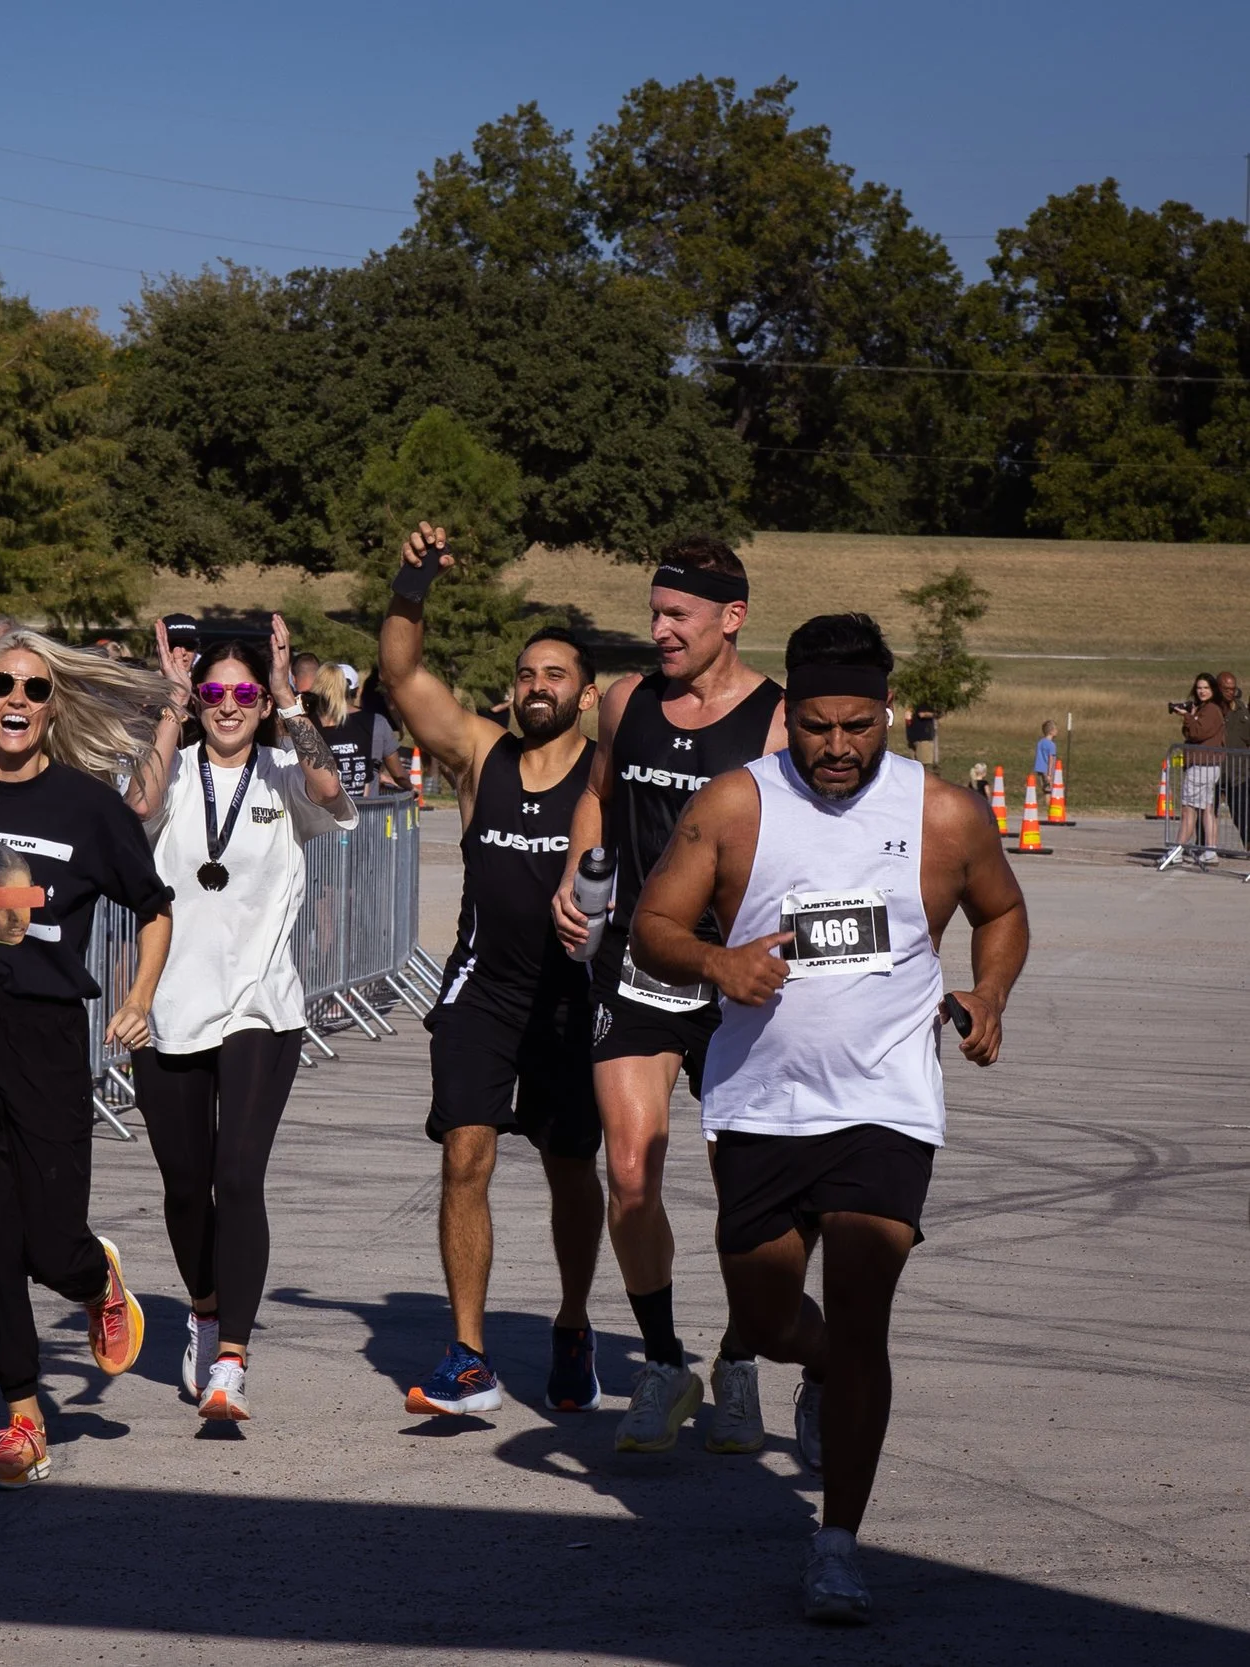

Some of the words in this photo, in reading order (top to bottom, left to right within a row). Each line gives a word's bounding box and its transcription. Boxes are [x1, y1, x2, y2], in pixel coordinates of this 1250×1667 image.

[9, 840, 37, 849] RUN
[480, 829, 569, 853] JUSTIC
[801, 900, 841, 910] JUSTICE
[842, 898, 865, 906] RUN
[810, 917, 860, 948] 466
[806, 958, 847, 967] JUSTICE
[848, 956, 870, 964] RUN
[636, 991, 671, 1003] JUSTICE
[672, 998, 692, 1006] RUN
